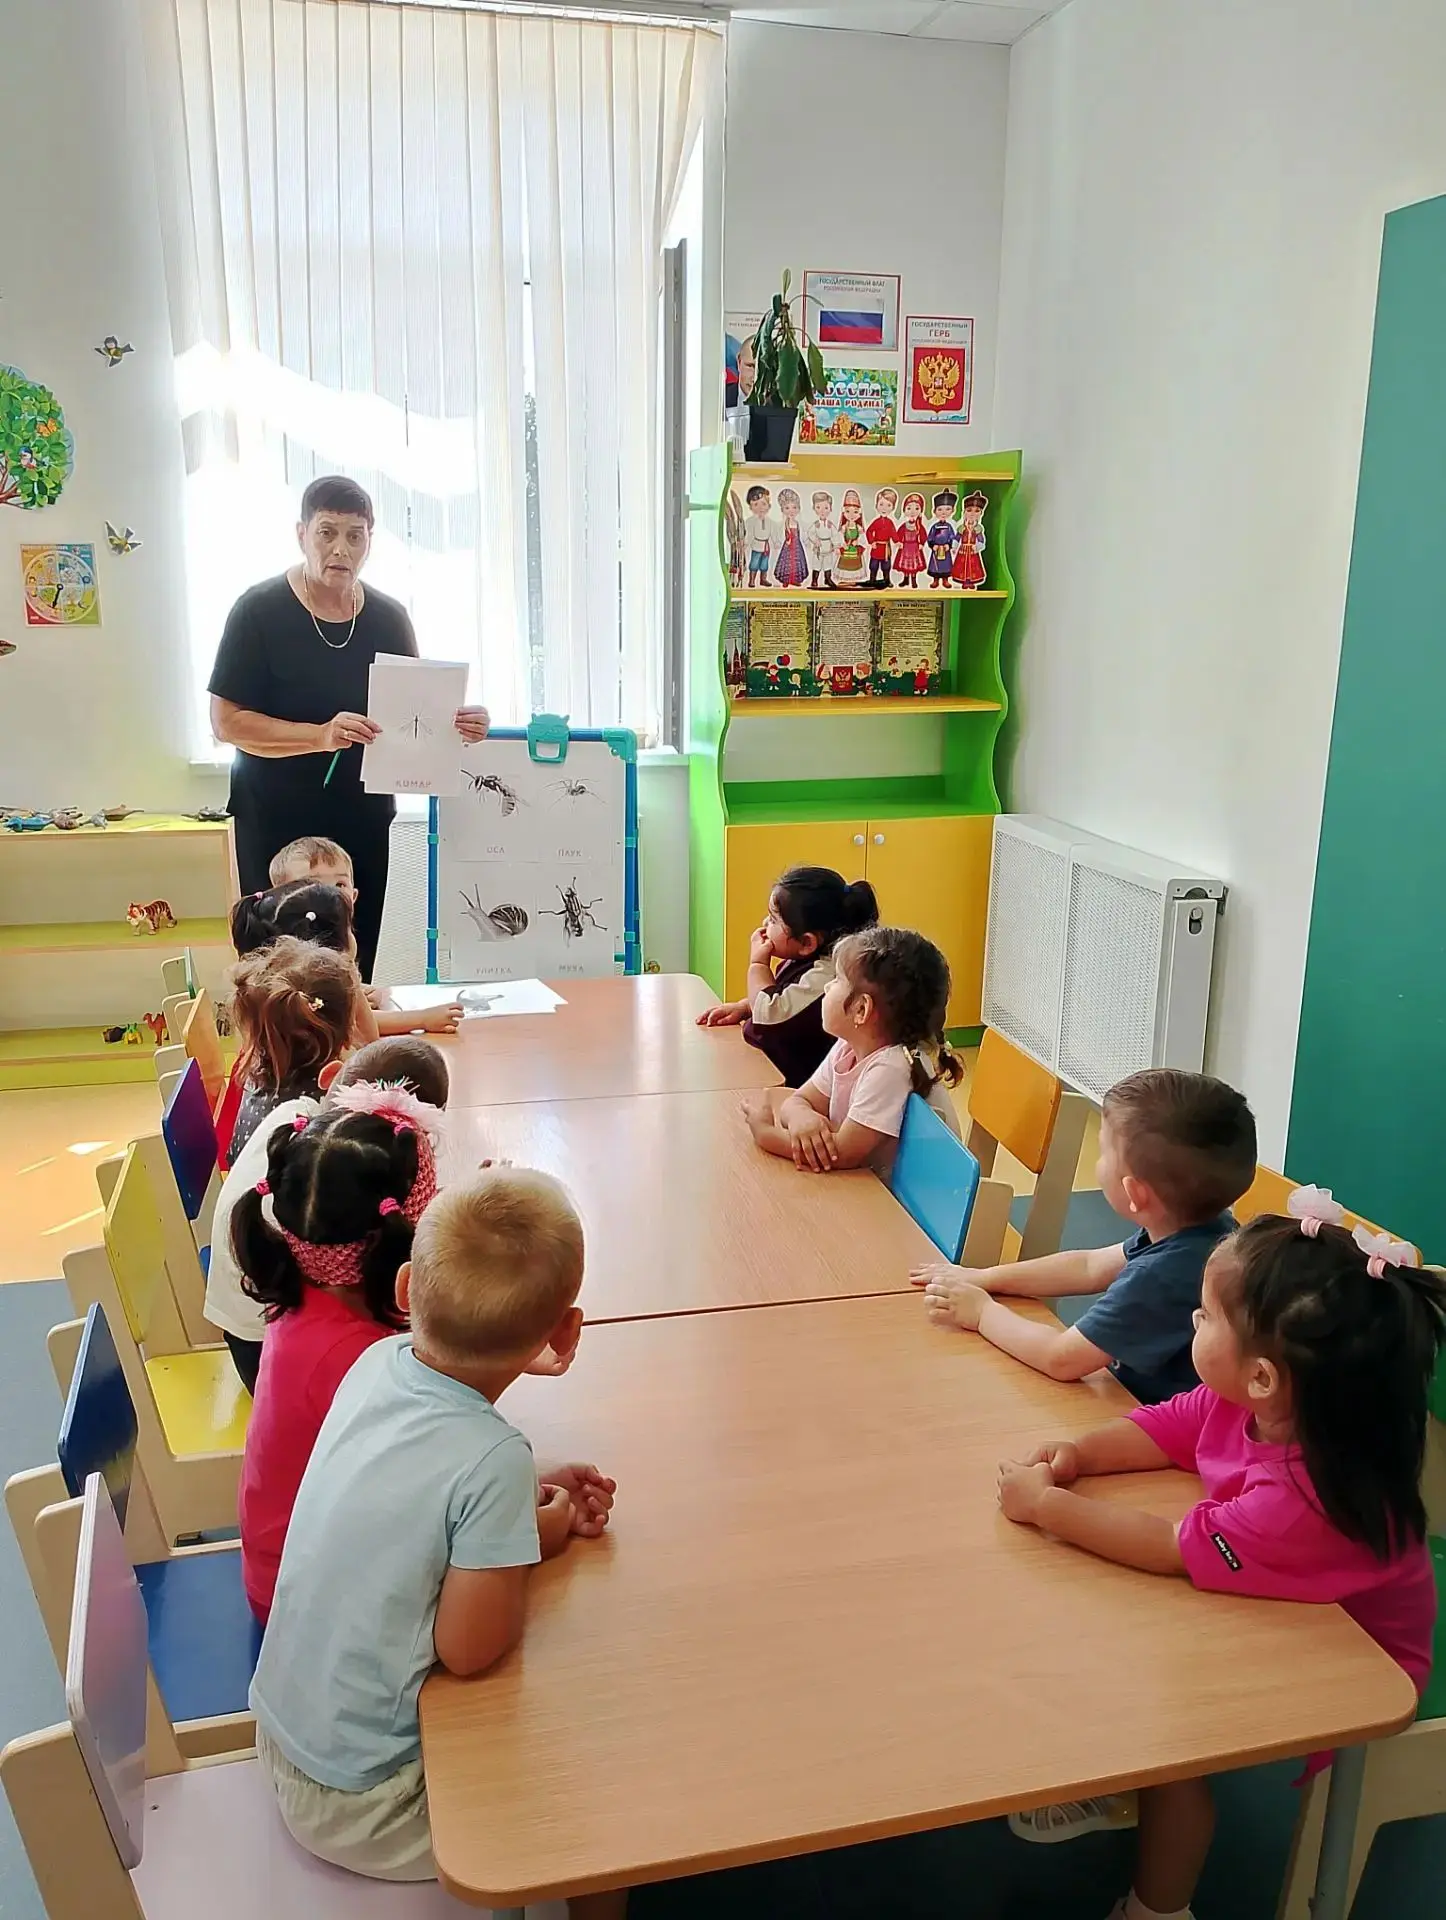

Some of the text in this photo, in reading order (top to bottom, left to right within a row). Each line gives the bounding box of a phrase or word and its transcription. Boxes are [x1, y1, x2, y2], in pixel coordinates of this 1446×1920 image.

[929, 329, 950, 338] ГЕРБ
[814, 381, 881, 398] ОССИЯ
[395, 779, 432, 789] КОМАР
[486, 846, 505, 855] ОСА
[558, 848, 582, 857] ПАУК
